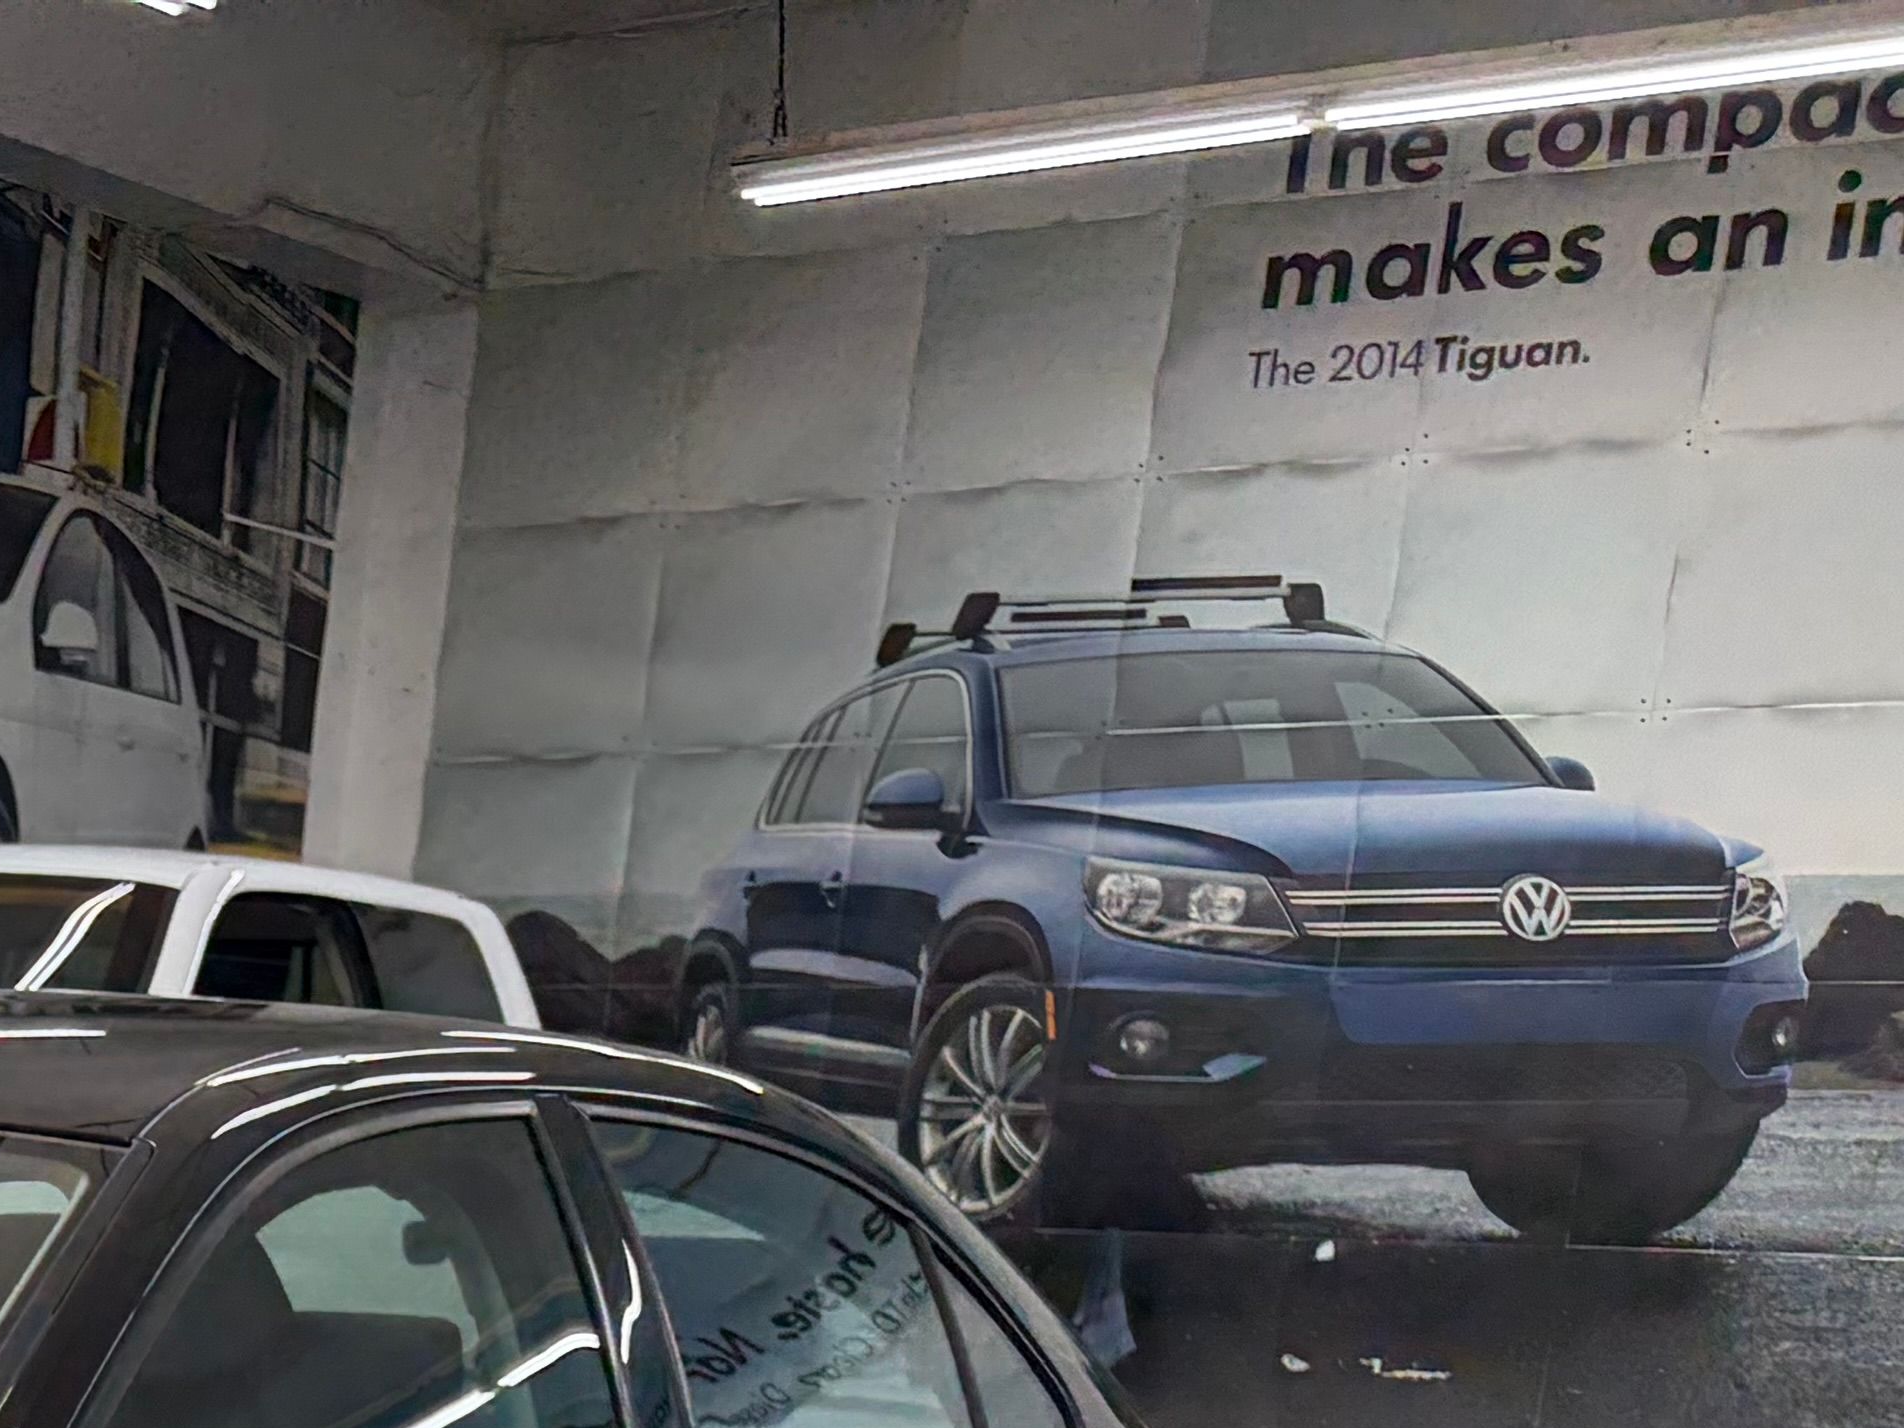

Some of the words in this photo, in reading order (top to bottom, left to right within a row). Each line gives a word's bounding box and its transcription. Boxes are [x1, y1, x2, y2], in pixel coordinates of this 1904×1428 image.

[1486, 71, 1904, 175] compac
[1260, 201, 1606, 311] makes
[1648, 207, 1790, 276] an
[1248, 348, 1316, 389] The
[1329, 339, 1425, 385] 2014
[1434, 335, 1591, 382] Tiguan.
[1502, 873, 1572, 942] VW
